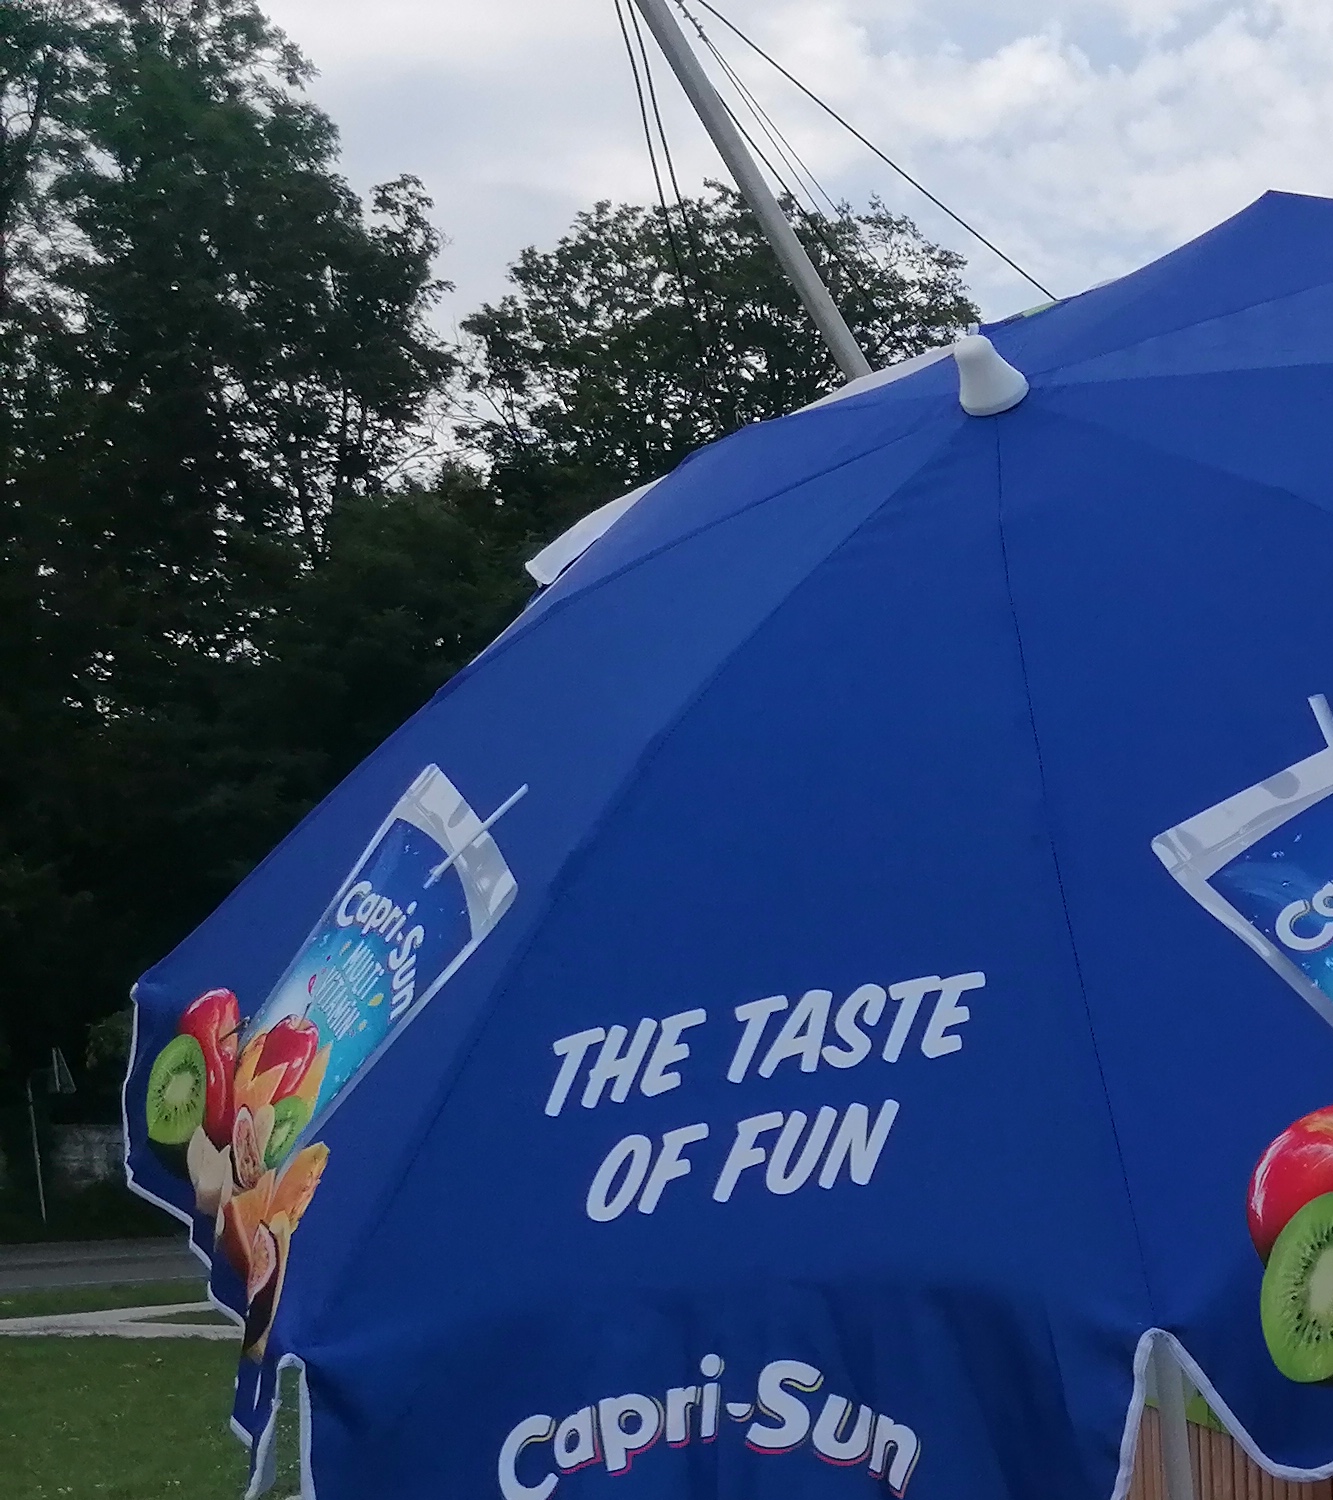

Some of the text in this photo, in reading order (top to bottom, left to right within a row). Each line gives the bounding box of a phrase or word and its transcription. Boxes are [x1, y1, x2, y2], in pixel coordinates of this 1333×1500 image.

[337, 881, 425, 1021] Capri-Sun
[544, 972, 986, 1117] THE TASTE
[587, 1100, 900, 1222] OF FUN
